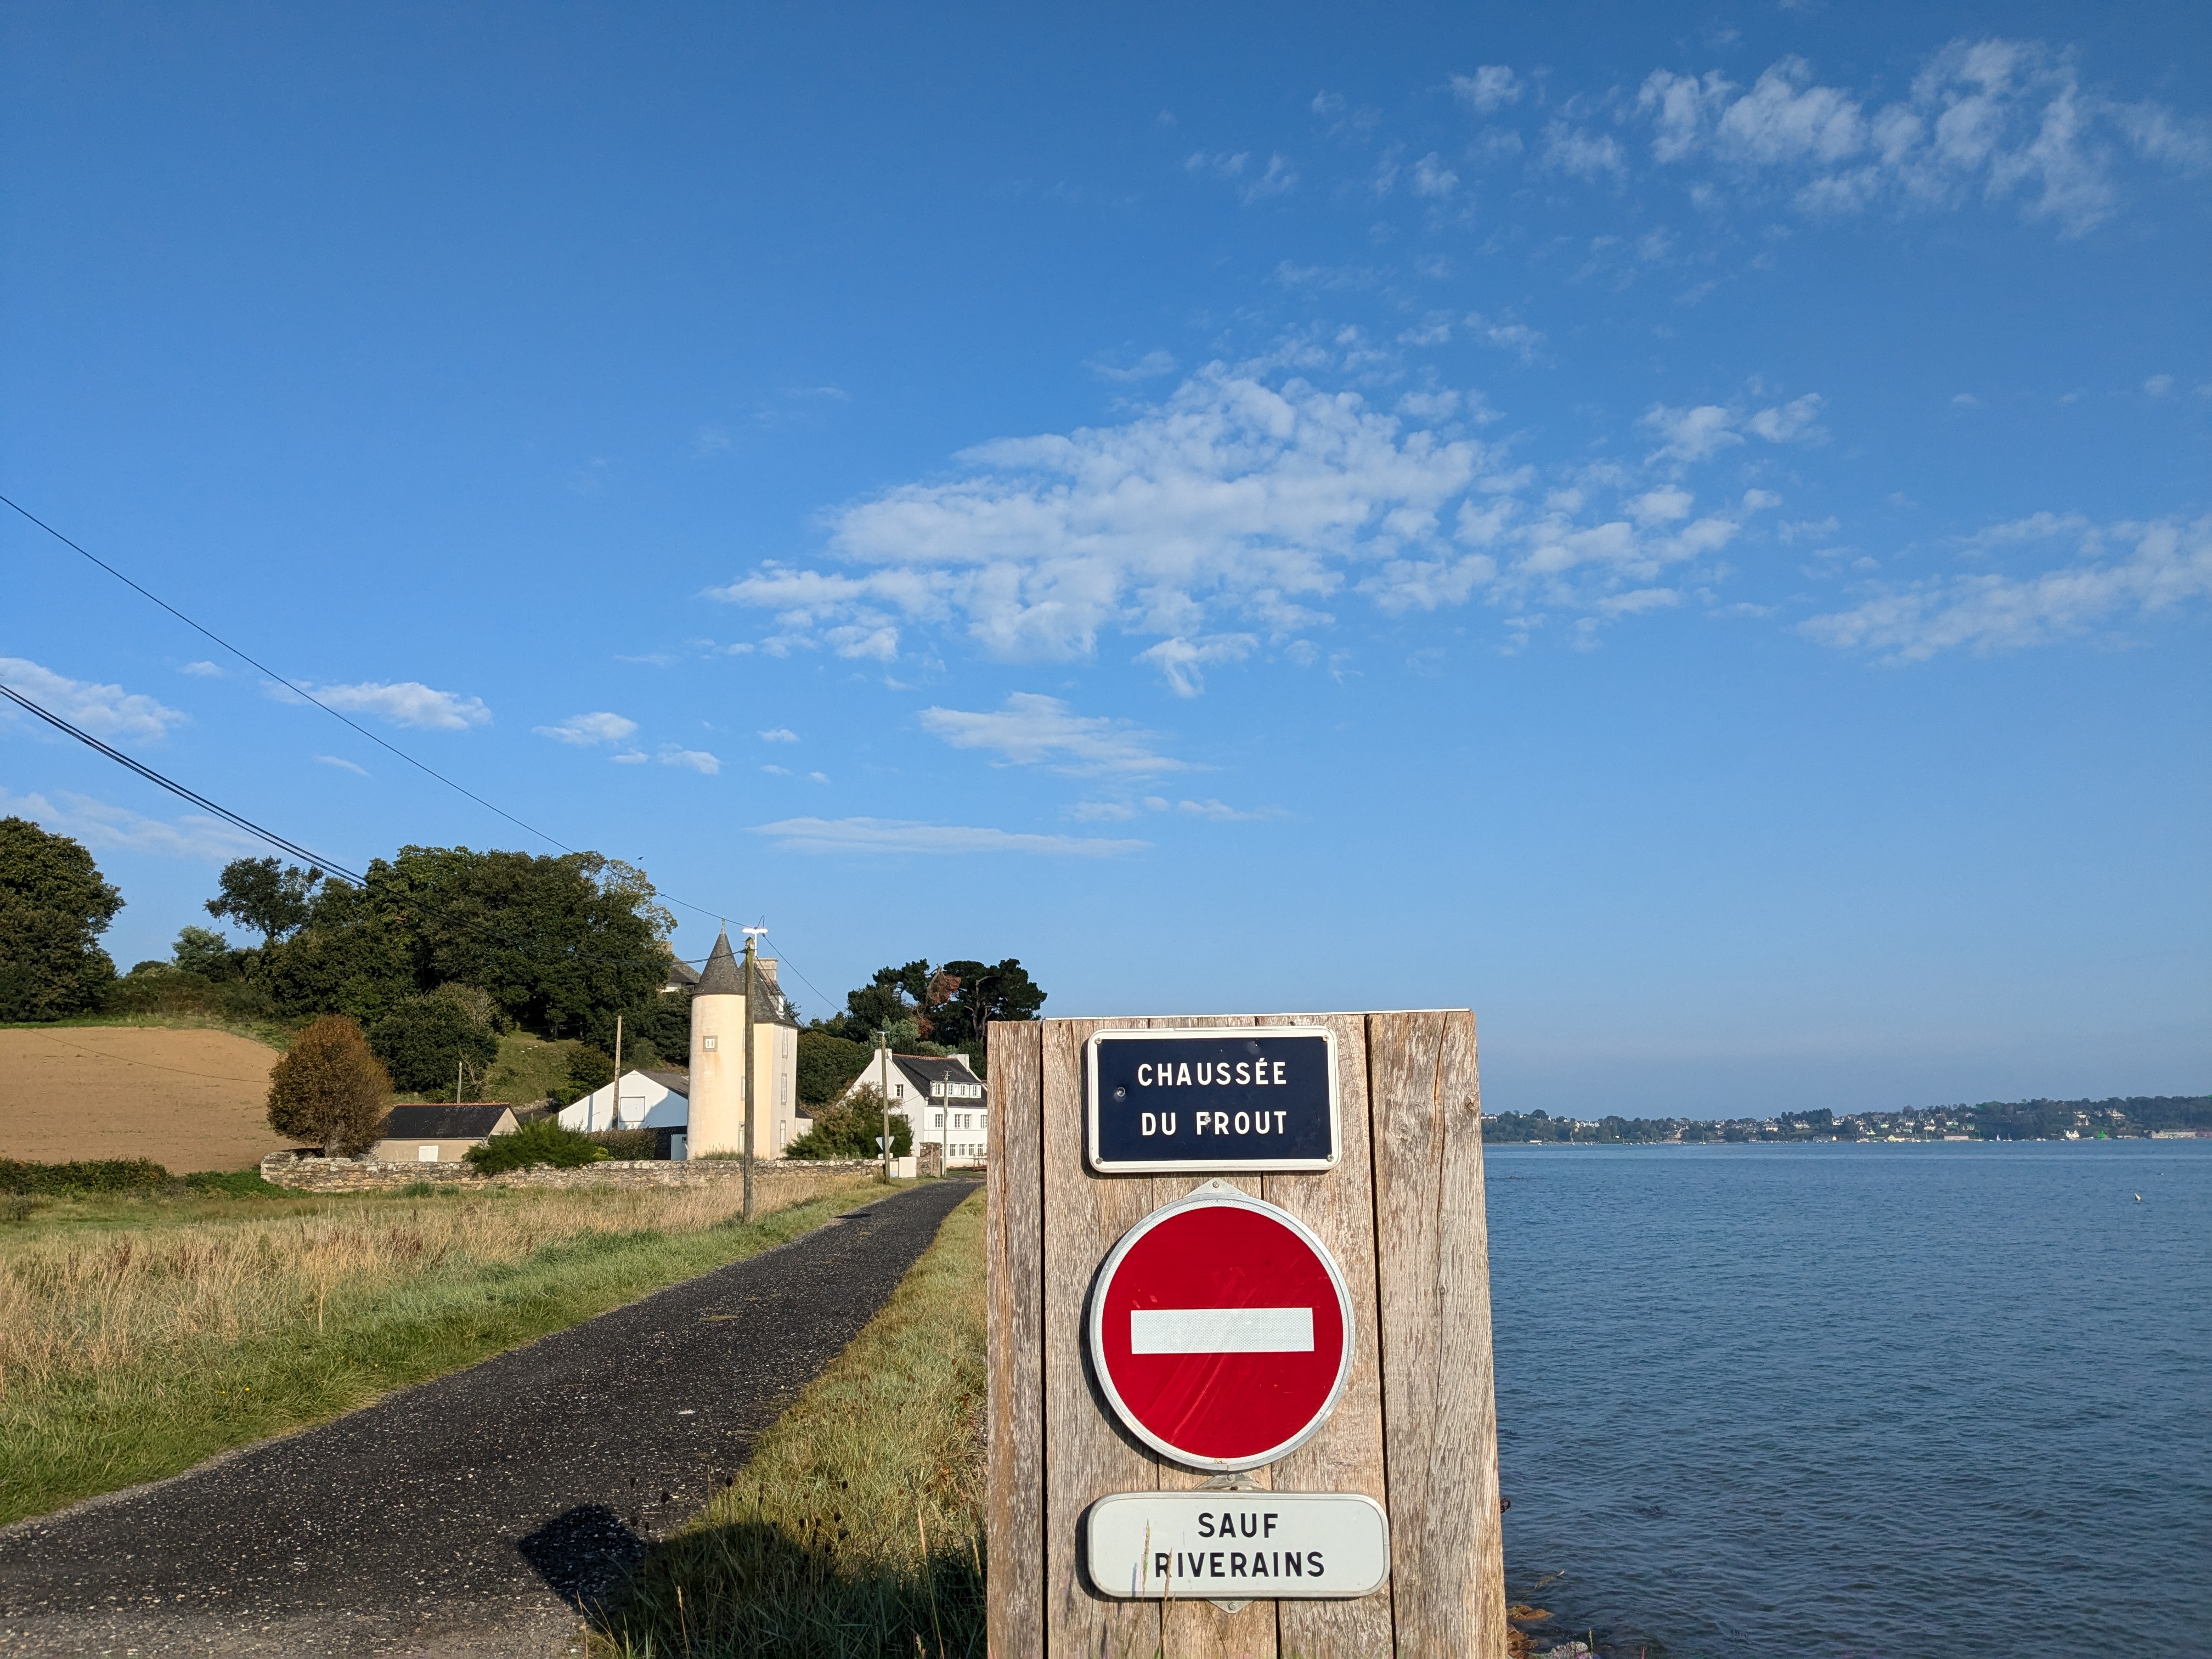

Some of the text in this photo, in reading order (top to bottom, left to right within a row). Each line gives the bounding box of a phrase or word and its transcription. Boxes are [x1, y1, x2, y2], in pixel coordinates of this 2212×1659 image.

[1138, 1057, 1287, 1086] CHAUSSÉE
[1142, 1111, 1287, 1136] DU FROUT
[1198, 1512, 1278, 1538] SAUF
[1155, 1551, 1325, 1578] RIVERAINS
